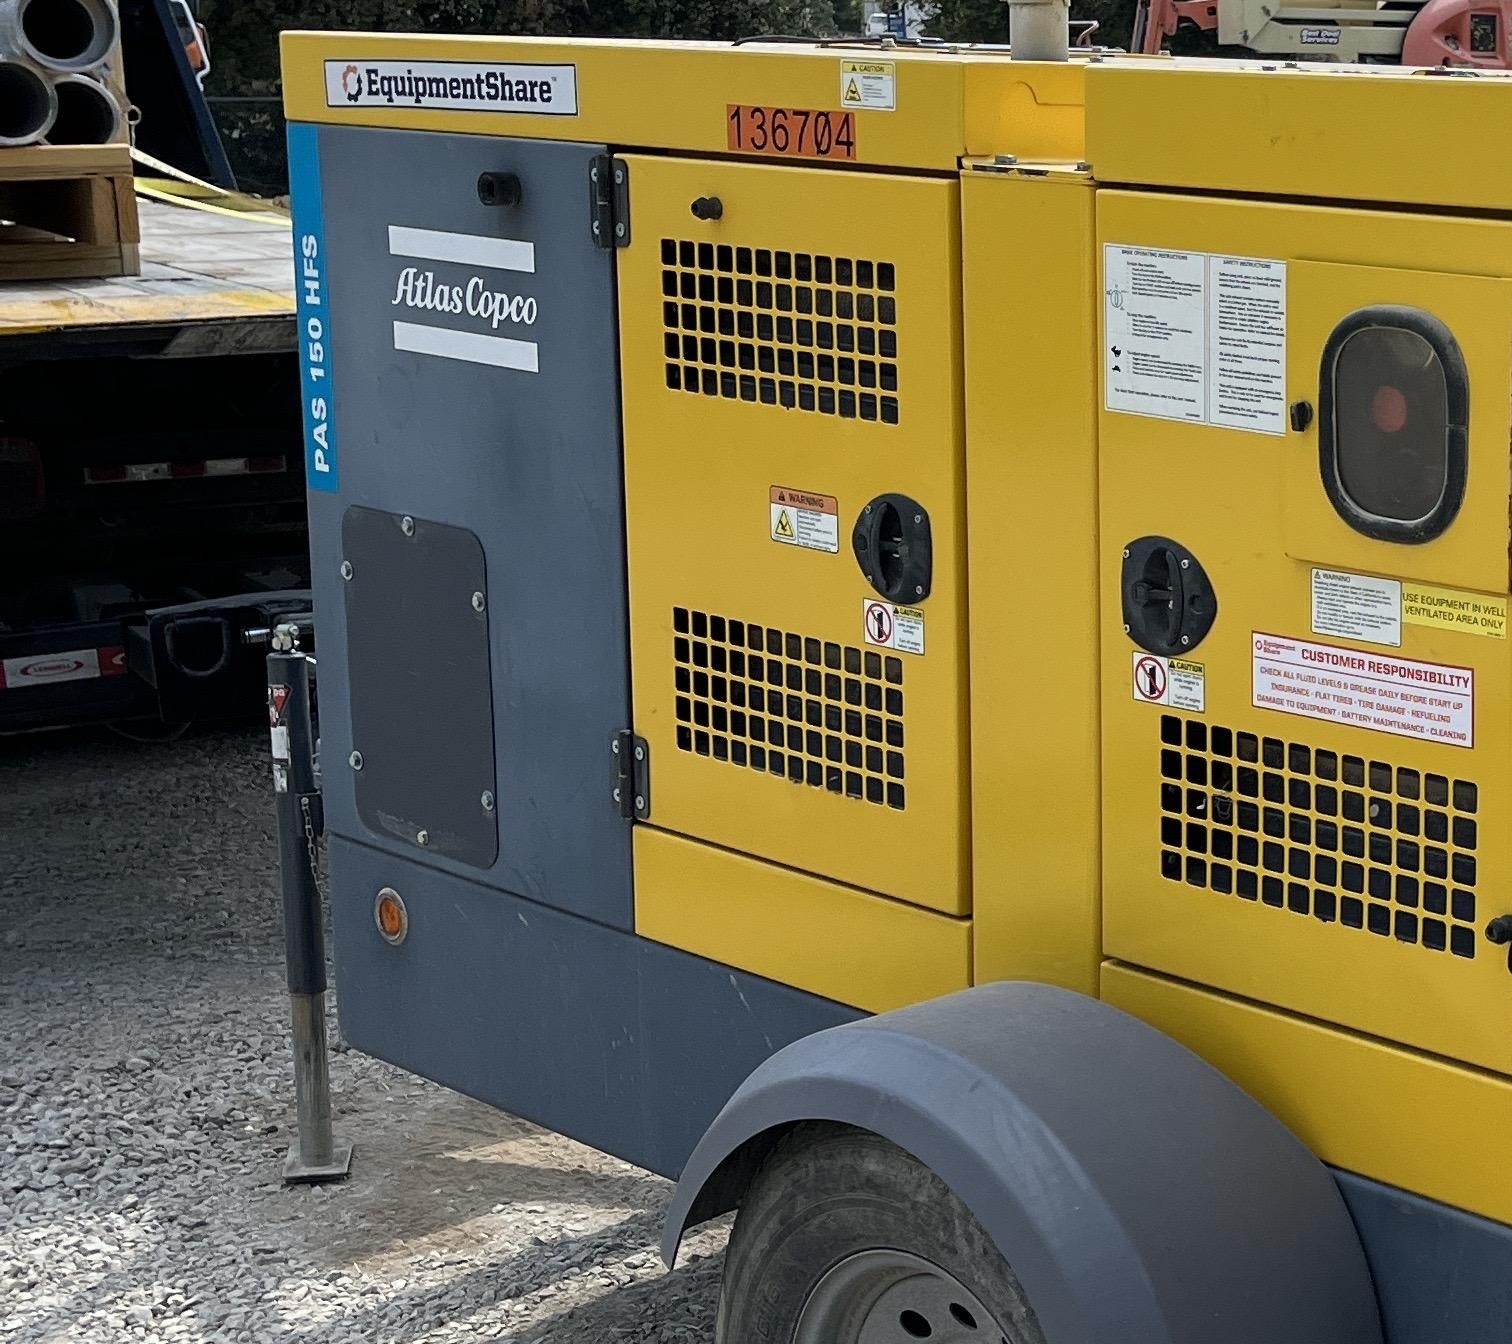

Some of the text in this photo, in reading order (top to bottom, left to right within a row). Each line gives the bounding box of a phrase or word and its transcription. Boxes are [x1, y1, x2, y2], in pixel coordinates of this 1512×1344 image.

[365, 68, 553, 104] EquipmentShare
[728, 109, 855, 157] 136704
[392, 267, 537, 327] Atlas Copco
[302, 234, 331, 473] PAS 150 HFS
[788, 493, 824, 509] WARNING
[1322, 573, 1351, 583] WARNING
[1402, 592, 1507, 618] USE EQUIPMENT IN WELL
[1405, 605, 1504, 630] VENTILATED AREA ONLY
[1176, 661, 1203, 673] CAUTION
[1301, 648, 1470, 689] CUSTOMER RESPONSIBILITY
[1259, 665, 1282, 676] CHECK
[1282, 669, 1295, 679] ALL
[1296, 671, 1316, 684] FLUID
[1317, 676, 1342, 689] LEVELS
[1350, 682, 1377, 695] GREASE
[1378, 687, 1400, 700] DAILY
[1400, 692, 1428, 705] BEFORE
[1428, 697, 1452, 709] START
[1453, 701, 1463, 711] UP
[1271, 682, 1451, 723] INSURANCE FLAT TIRES TIRE DAMAGE REFUELING
[1256, 693, 1467, 741] DAMAGE TO EQUIPMENT BATTERY MAINTENANCE CLEANING
